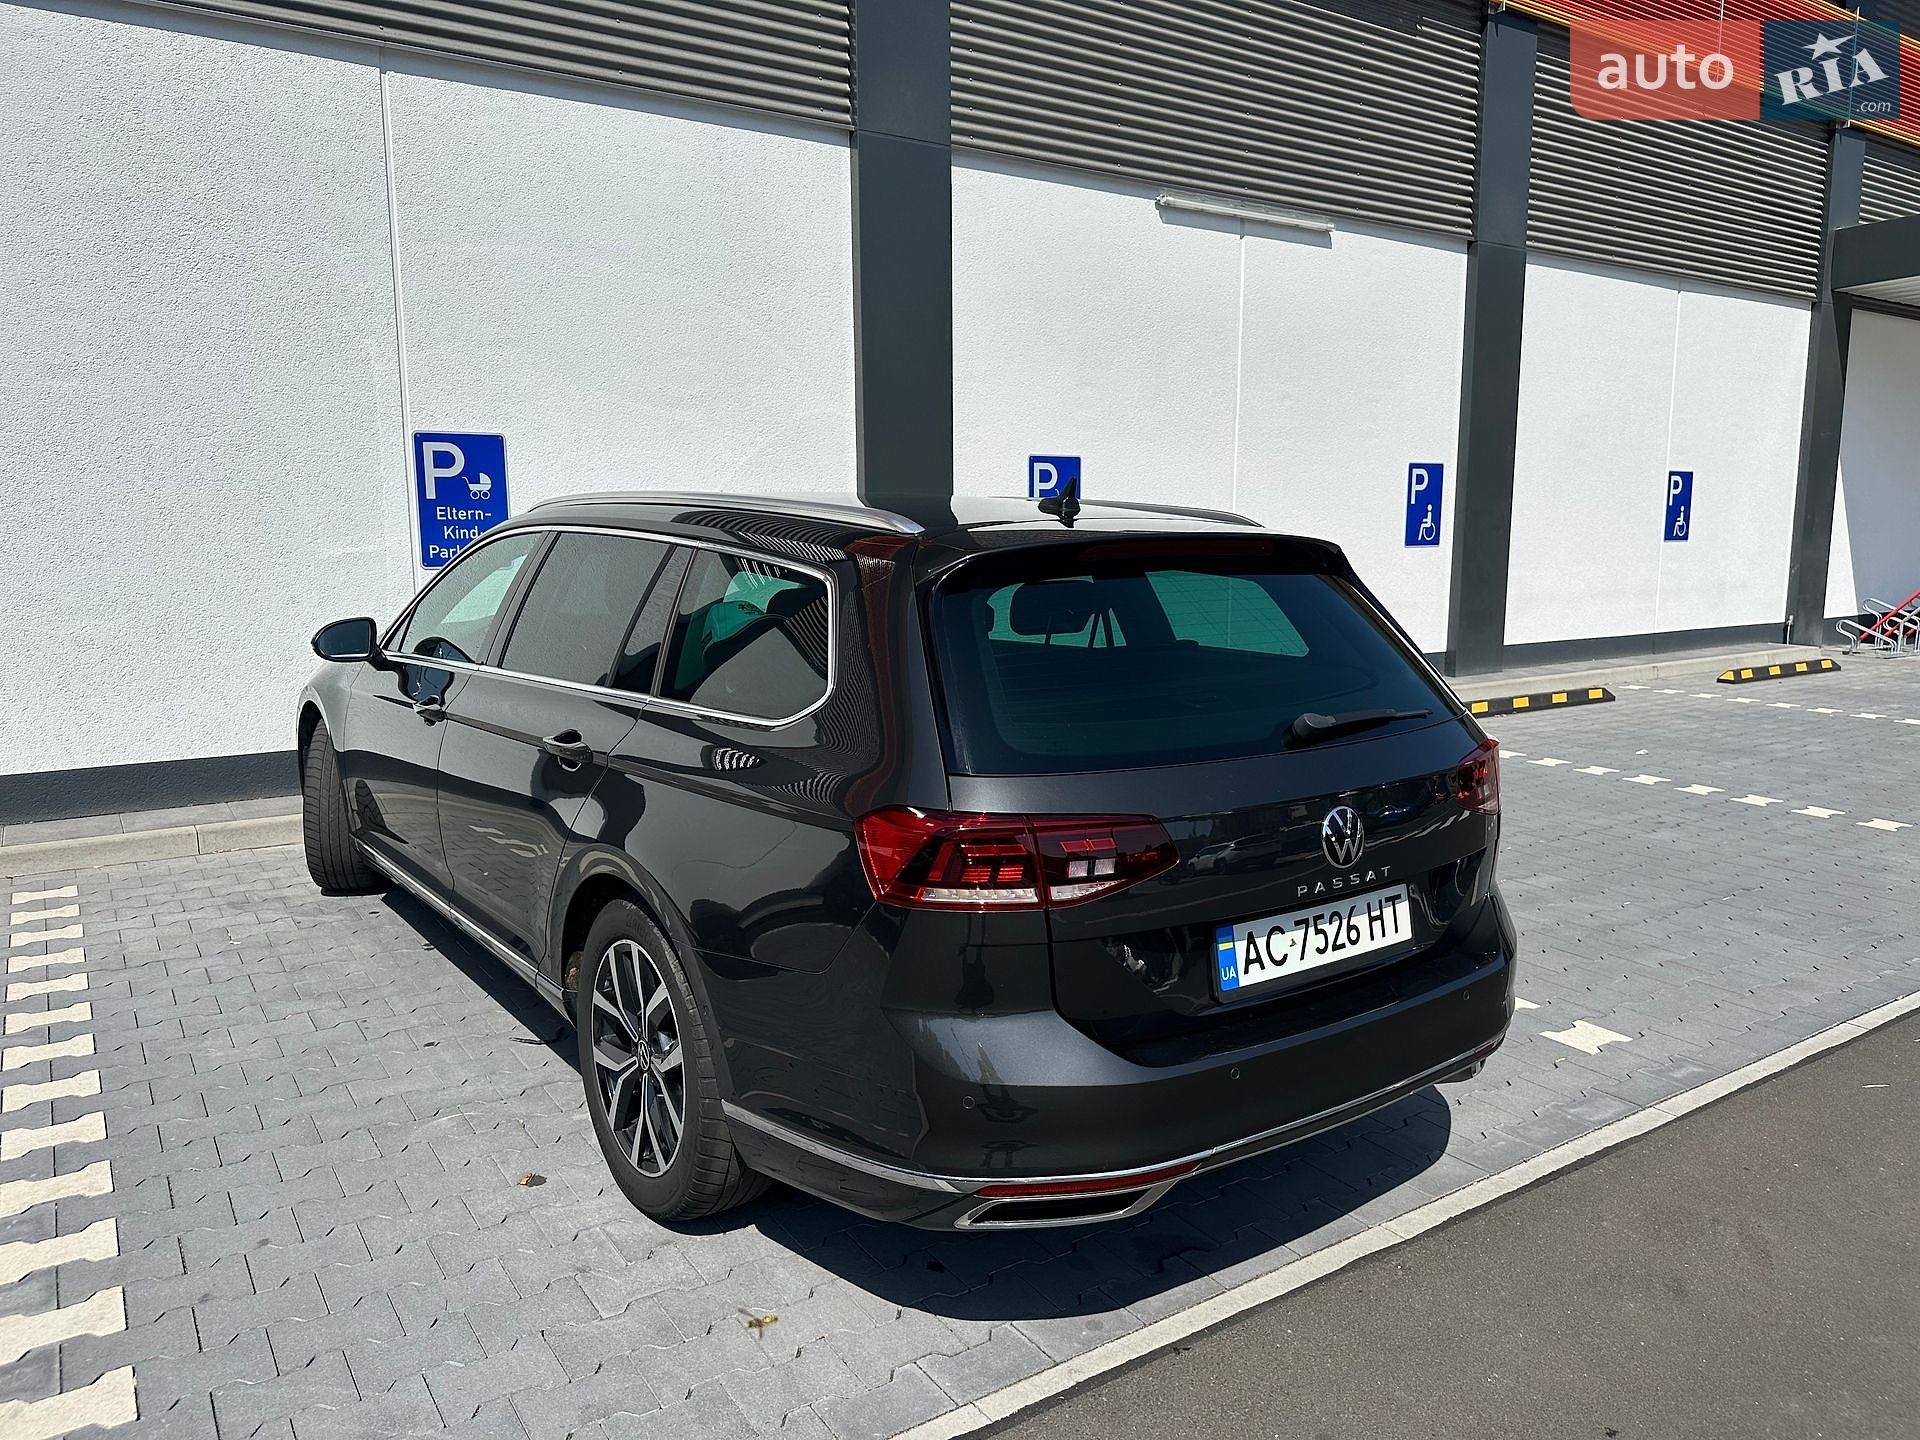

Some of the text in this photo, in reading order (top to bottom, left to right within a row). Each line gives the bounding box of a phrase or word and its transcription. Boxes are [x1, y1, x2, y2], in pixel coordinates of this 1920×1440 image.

[422, 441, 465, 499] P
[1033, 462, 1058, 499] P
[1410, 468, 1429, 505] P
[1669, 475, 1683, 506] P
[436, 506, 492, 520] Eltern-
[1297, 865, 1391, 898] PASSAT
[1243, 893, 1402, 975] AC 7526 HT
[1221, 965, 1238, 980] UA
